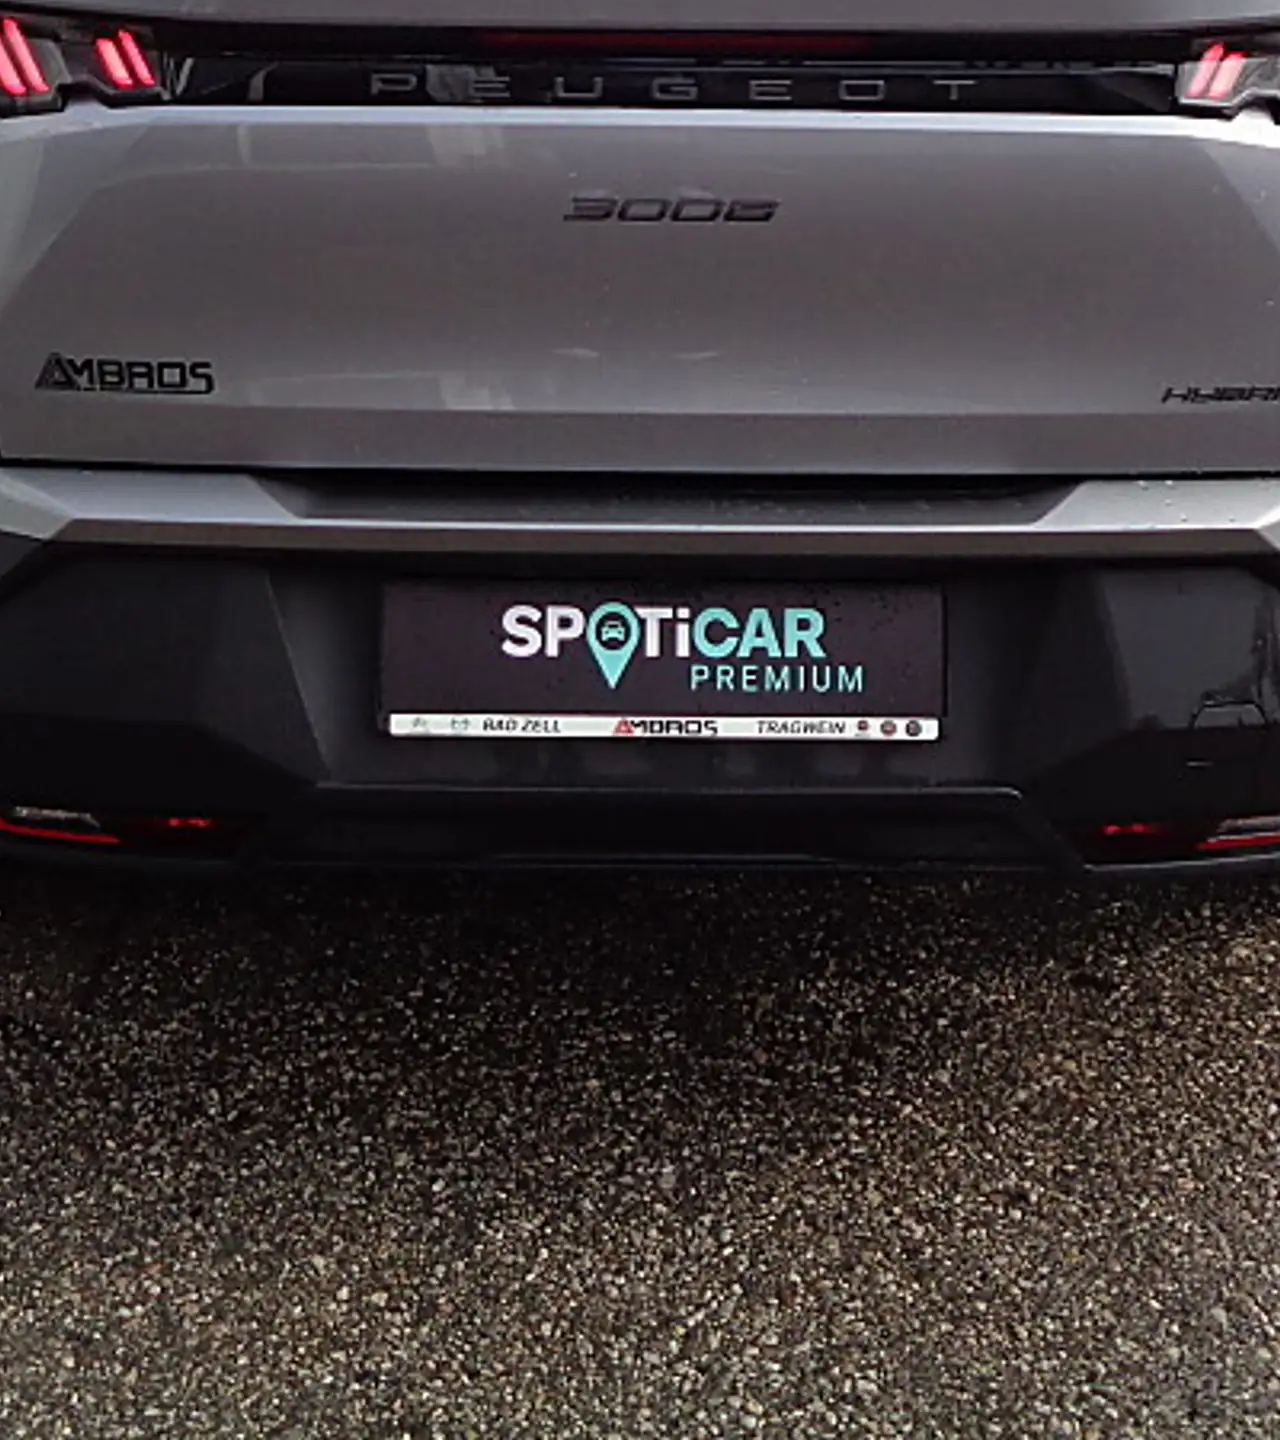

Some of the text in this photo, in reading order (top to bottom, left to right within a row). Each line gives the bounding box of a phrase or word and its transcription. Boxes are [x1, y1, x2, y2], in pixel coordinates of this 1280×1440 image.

[370, 73, 977, 101] PEUGEOT
[34, 351, 214, 395] AMBROS
[690, 664, 865, 693] PREMIUM
